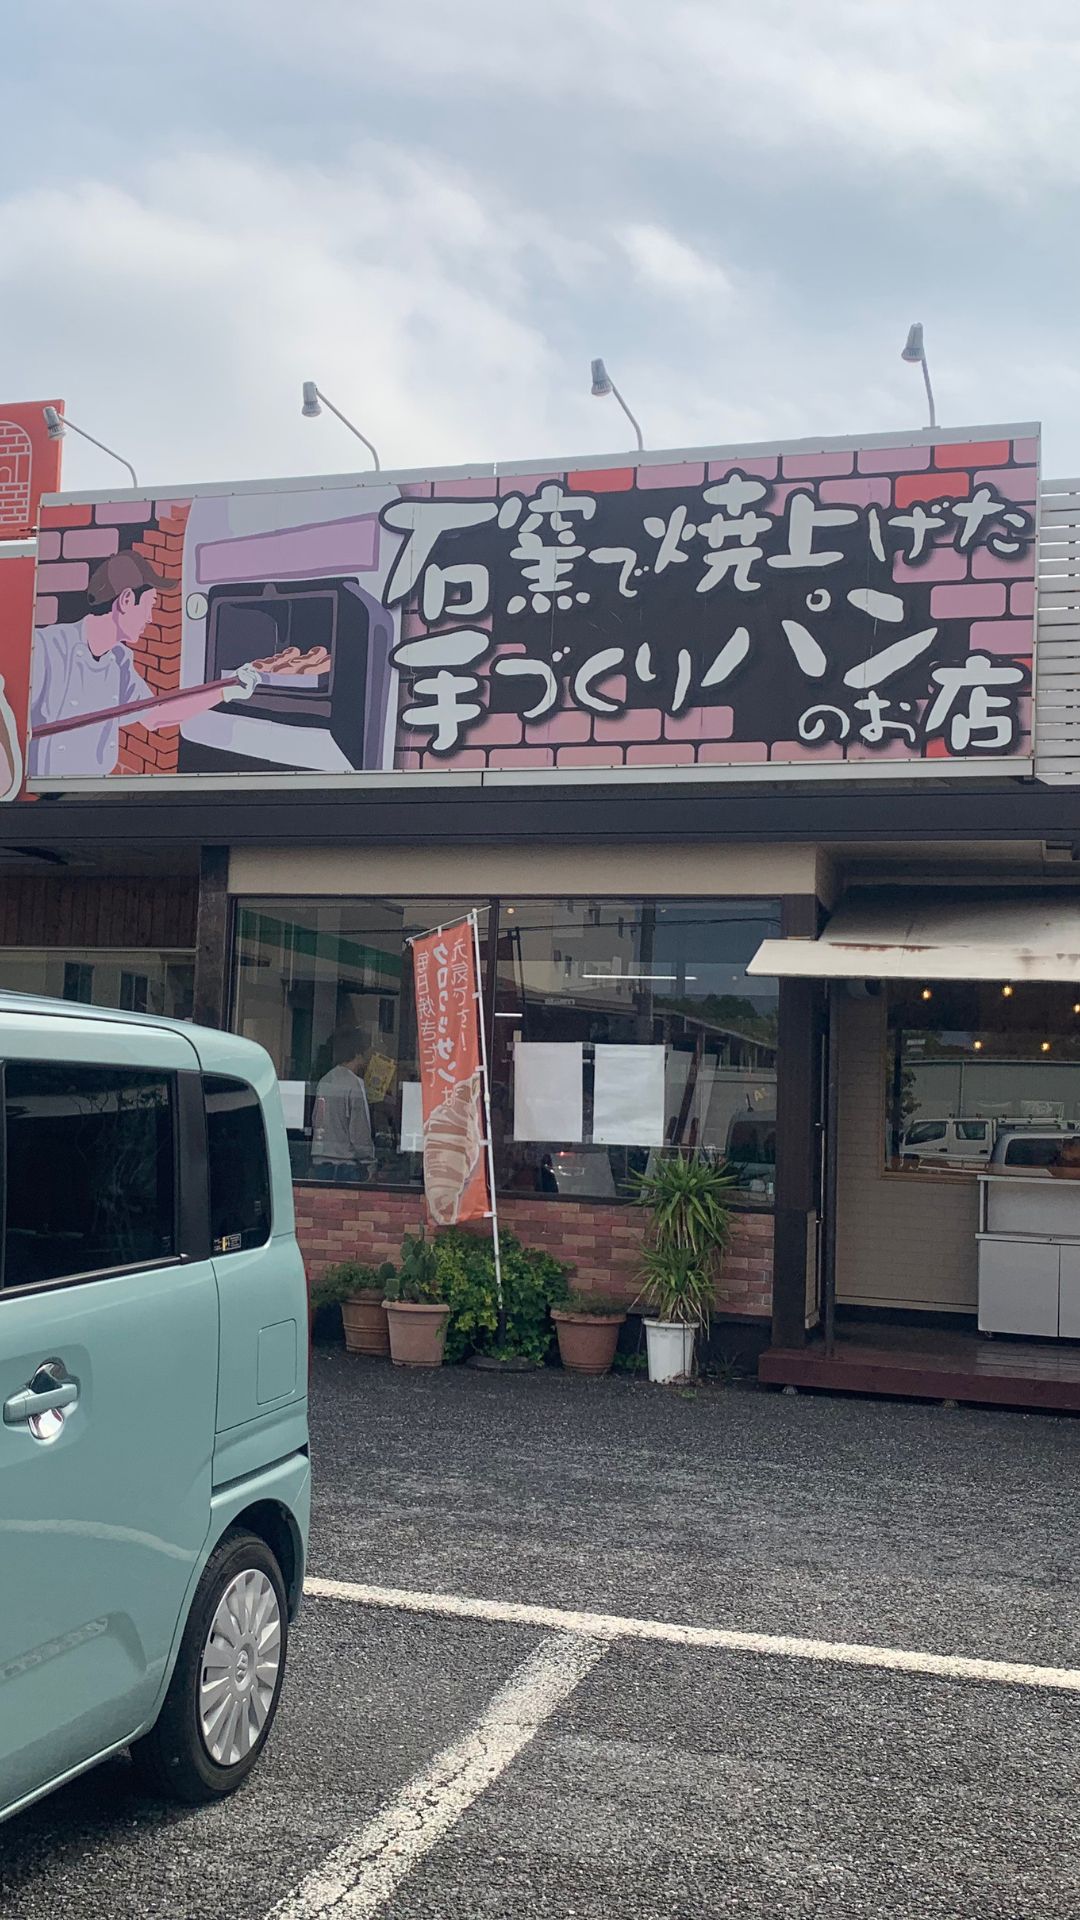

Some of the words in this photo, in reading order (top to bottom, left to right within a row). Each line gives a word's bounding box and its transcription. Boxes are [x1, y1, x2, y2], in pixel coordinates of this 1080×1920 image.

[384, 474, 1027, 620] 石窯で焼上げた
